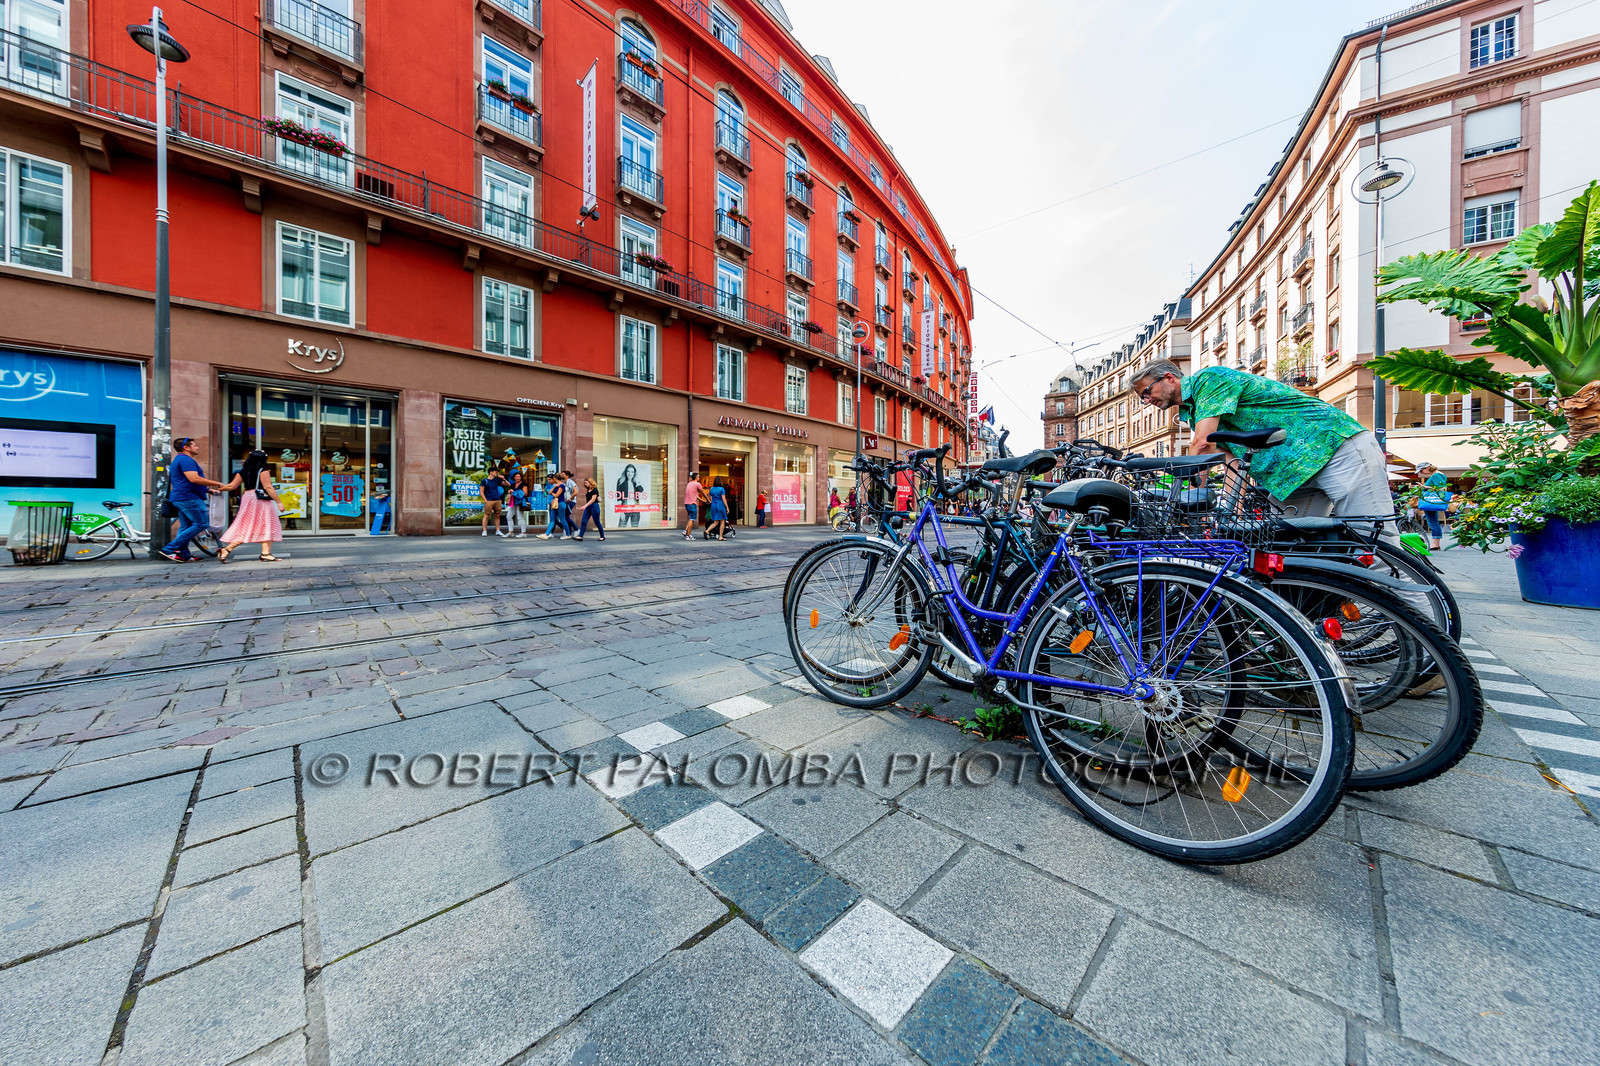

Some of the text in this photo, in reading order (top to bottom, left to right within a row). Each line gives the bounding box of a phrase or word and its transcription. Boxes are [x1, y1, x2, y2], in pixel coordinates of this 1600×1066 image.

[287, 338, 338, 363] Krys
[0, 369, 47, 388] rys
[881, 361, 909, 389] HOTEL
[516, 397, 549, 406] OPTICIEN
[718, 415, 770, 432] ARMAND
[453, 428, 485, 441] TESTEZ
[453, 439, 485, 452] VOTRE
[453, 451, 485, 469] VUE
[608, 490, 648, 500] SOLDES
